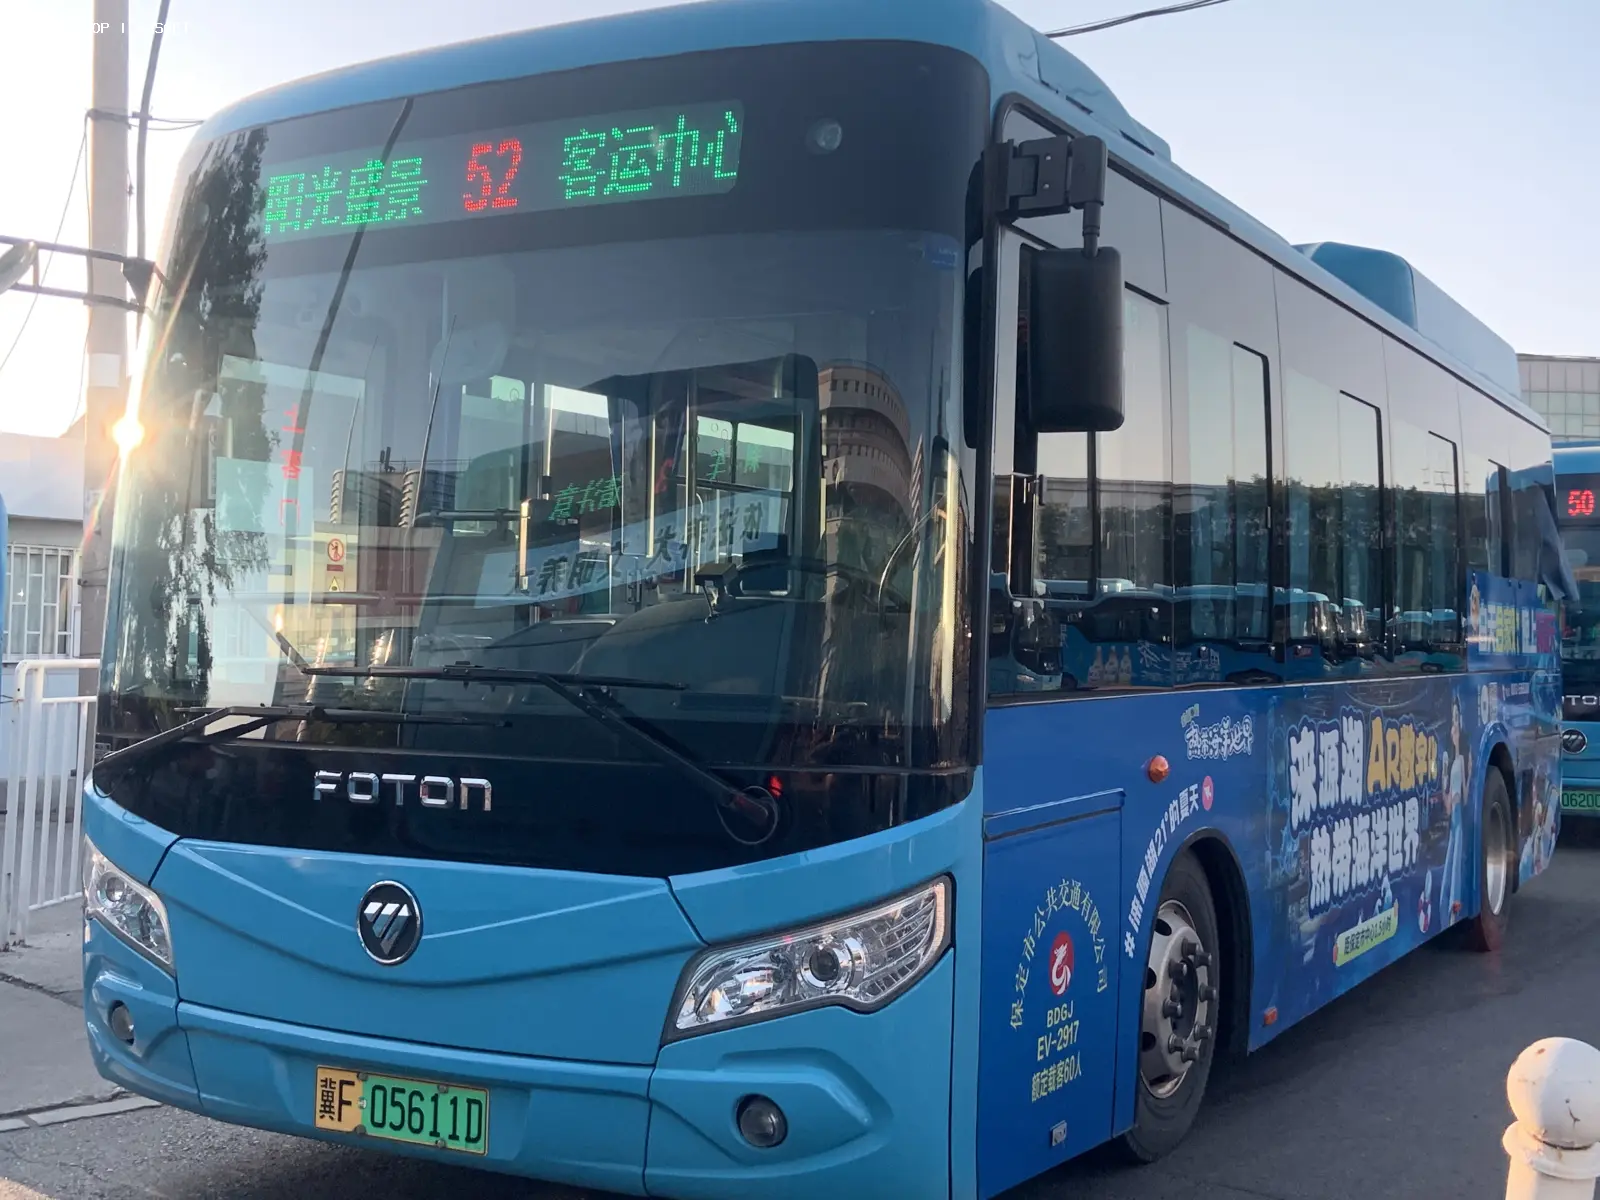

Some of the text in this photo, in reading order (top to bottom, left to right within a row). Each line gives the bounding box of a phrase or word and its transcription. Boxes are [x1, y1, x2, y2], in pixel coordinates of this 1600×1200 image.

[263, 110, 740, 234] 阳光盛景 52 客运中心
[1567, 489, 1595, 516] 50
[313, 769, 492, 811] FOTON
[1310, 797, 1419, 910] 热带海洋世界
[1010, 878, 1108, 1030] 保定市公共交通有限公司
[1046, 1000, 1074, 1028] BDGJ
[1036, 1020, 1080, 1062] EV-2917
[1031, 1050, 1082, 1102] 额定载客60人
[319, 1077, 484, 1144] 冀F 05611D
